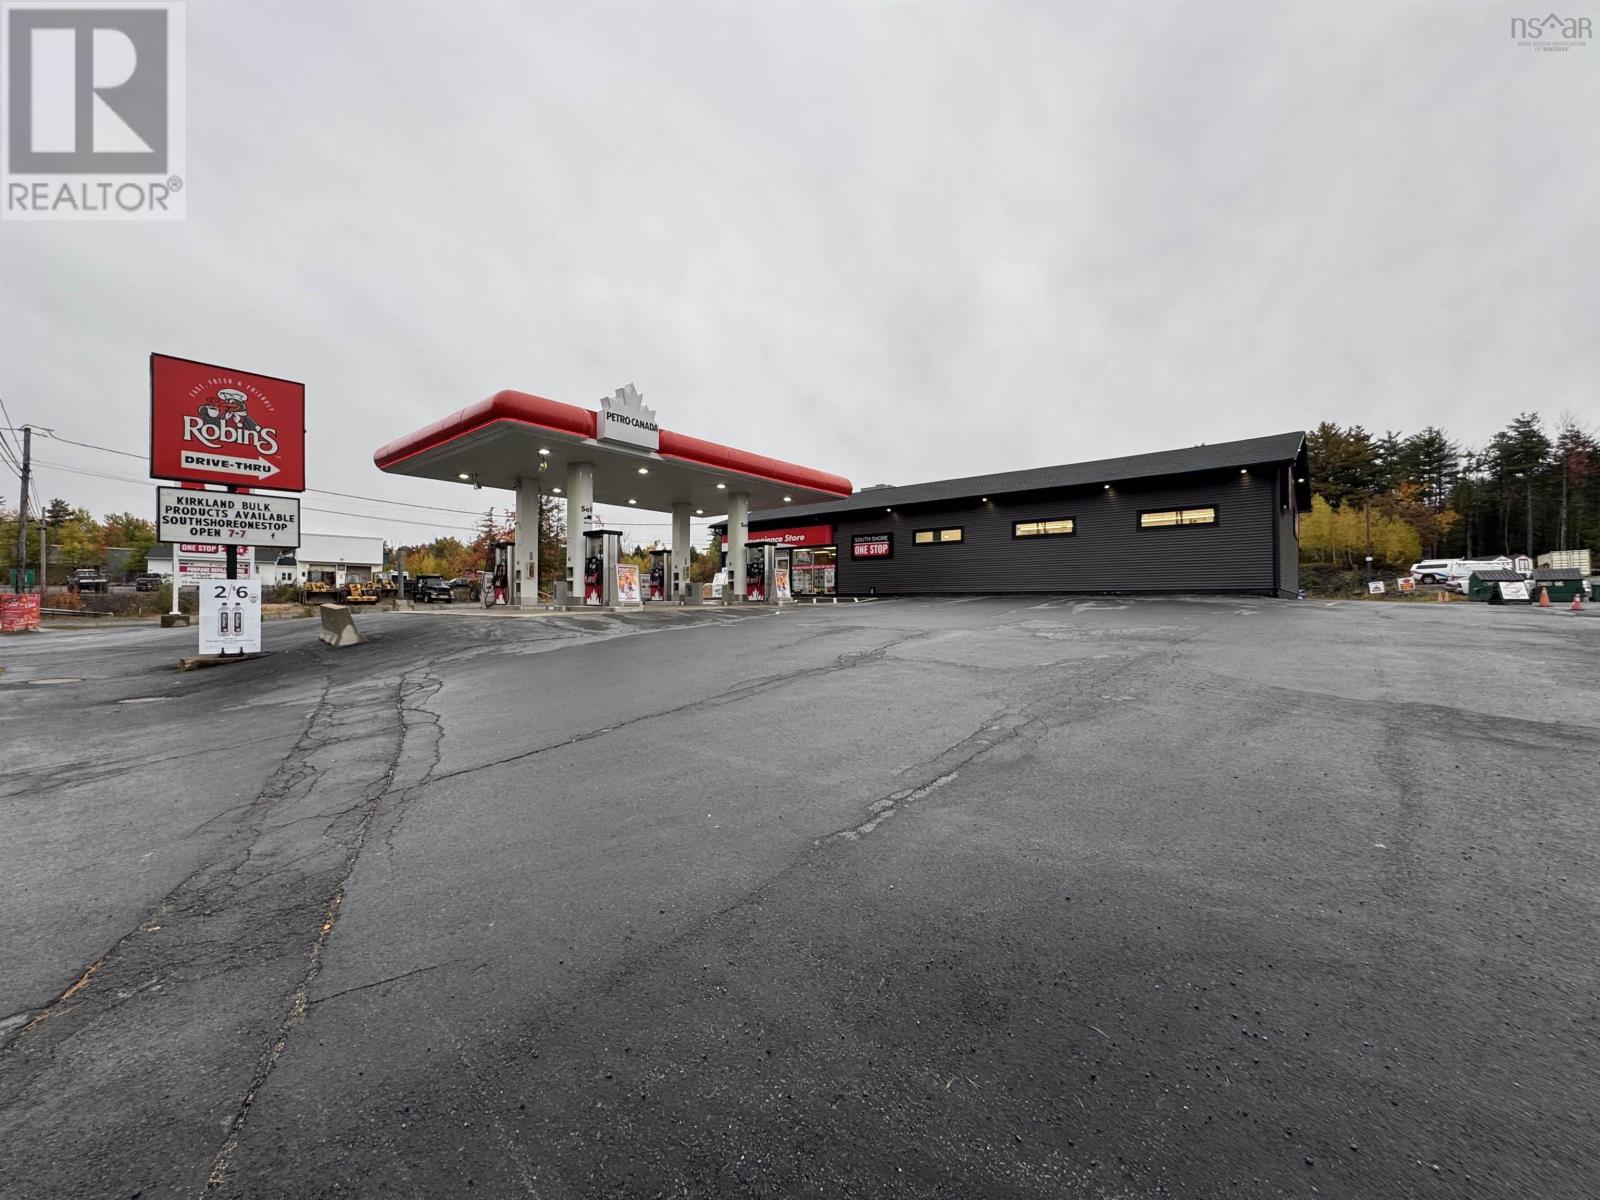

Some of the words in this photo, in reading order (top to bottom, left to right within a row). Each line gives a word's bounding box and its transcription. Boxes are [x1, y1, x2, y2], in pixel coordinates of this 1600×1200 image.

[184, 455, 272, 474] DRIVE-THRU
[176, 496, 235, 509] KIRKLAND
[242, 501, 271, 512] BULK
[165, 505, 229, 518] PRODUCTS
[235, 510, 296, 523] AVAILABLE
[162, 515, 288, 531] SOUTHSHOREONESTOP
[190, 527, 221, 537] OPEN
[228, 529, 247, 538] 7-7
[785, 534, 805, 542] Store
[854, 545, 869, 555] ONE
[869, 544, 888, 554] STOP
